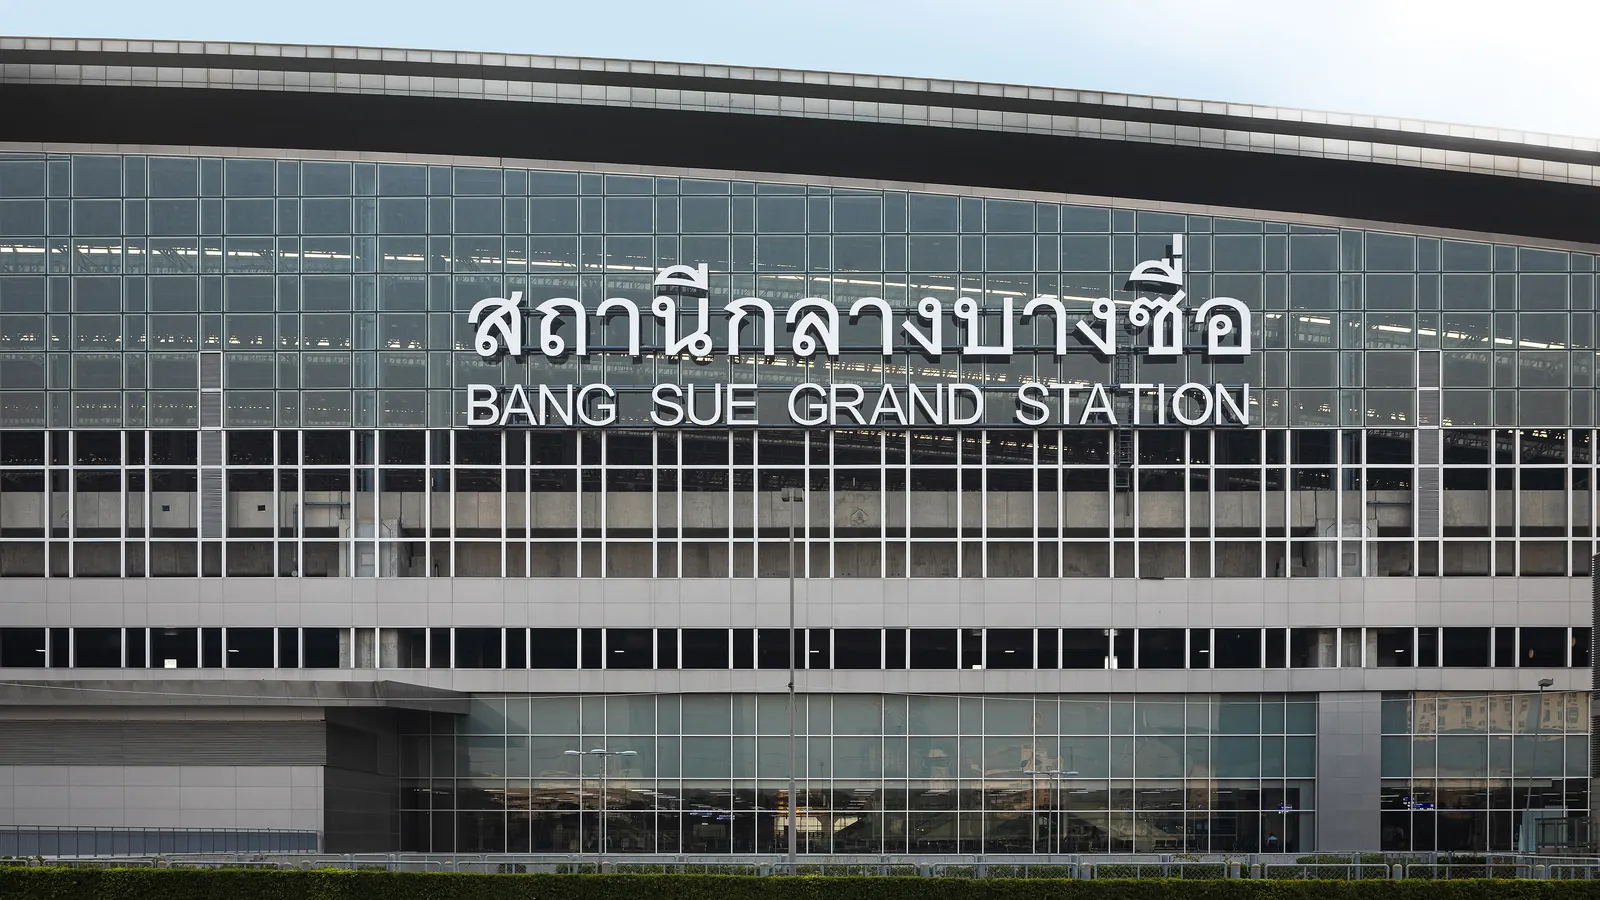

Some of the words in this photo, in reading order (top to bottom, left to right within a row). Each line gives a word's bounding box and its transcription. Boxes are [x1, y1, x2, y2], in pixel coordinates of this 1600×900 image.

[467, 233, 1251, 357] สถานีกลางบางซื่อ
[467, 383, 616, 426] BANG
[650, 383, 759, 427] SUE
[788, 383, 984, 426] GRAND
[1015, 382, 1250, 426] STATION
